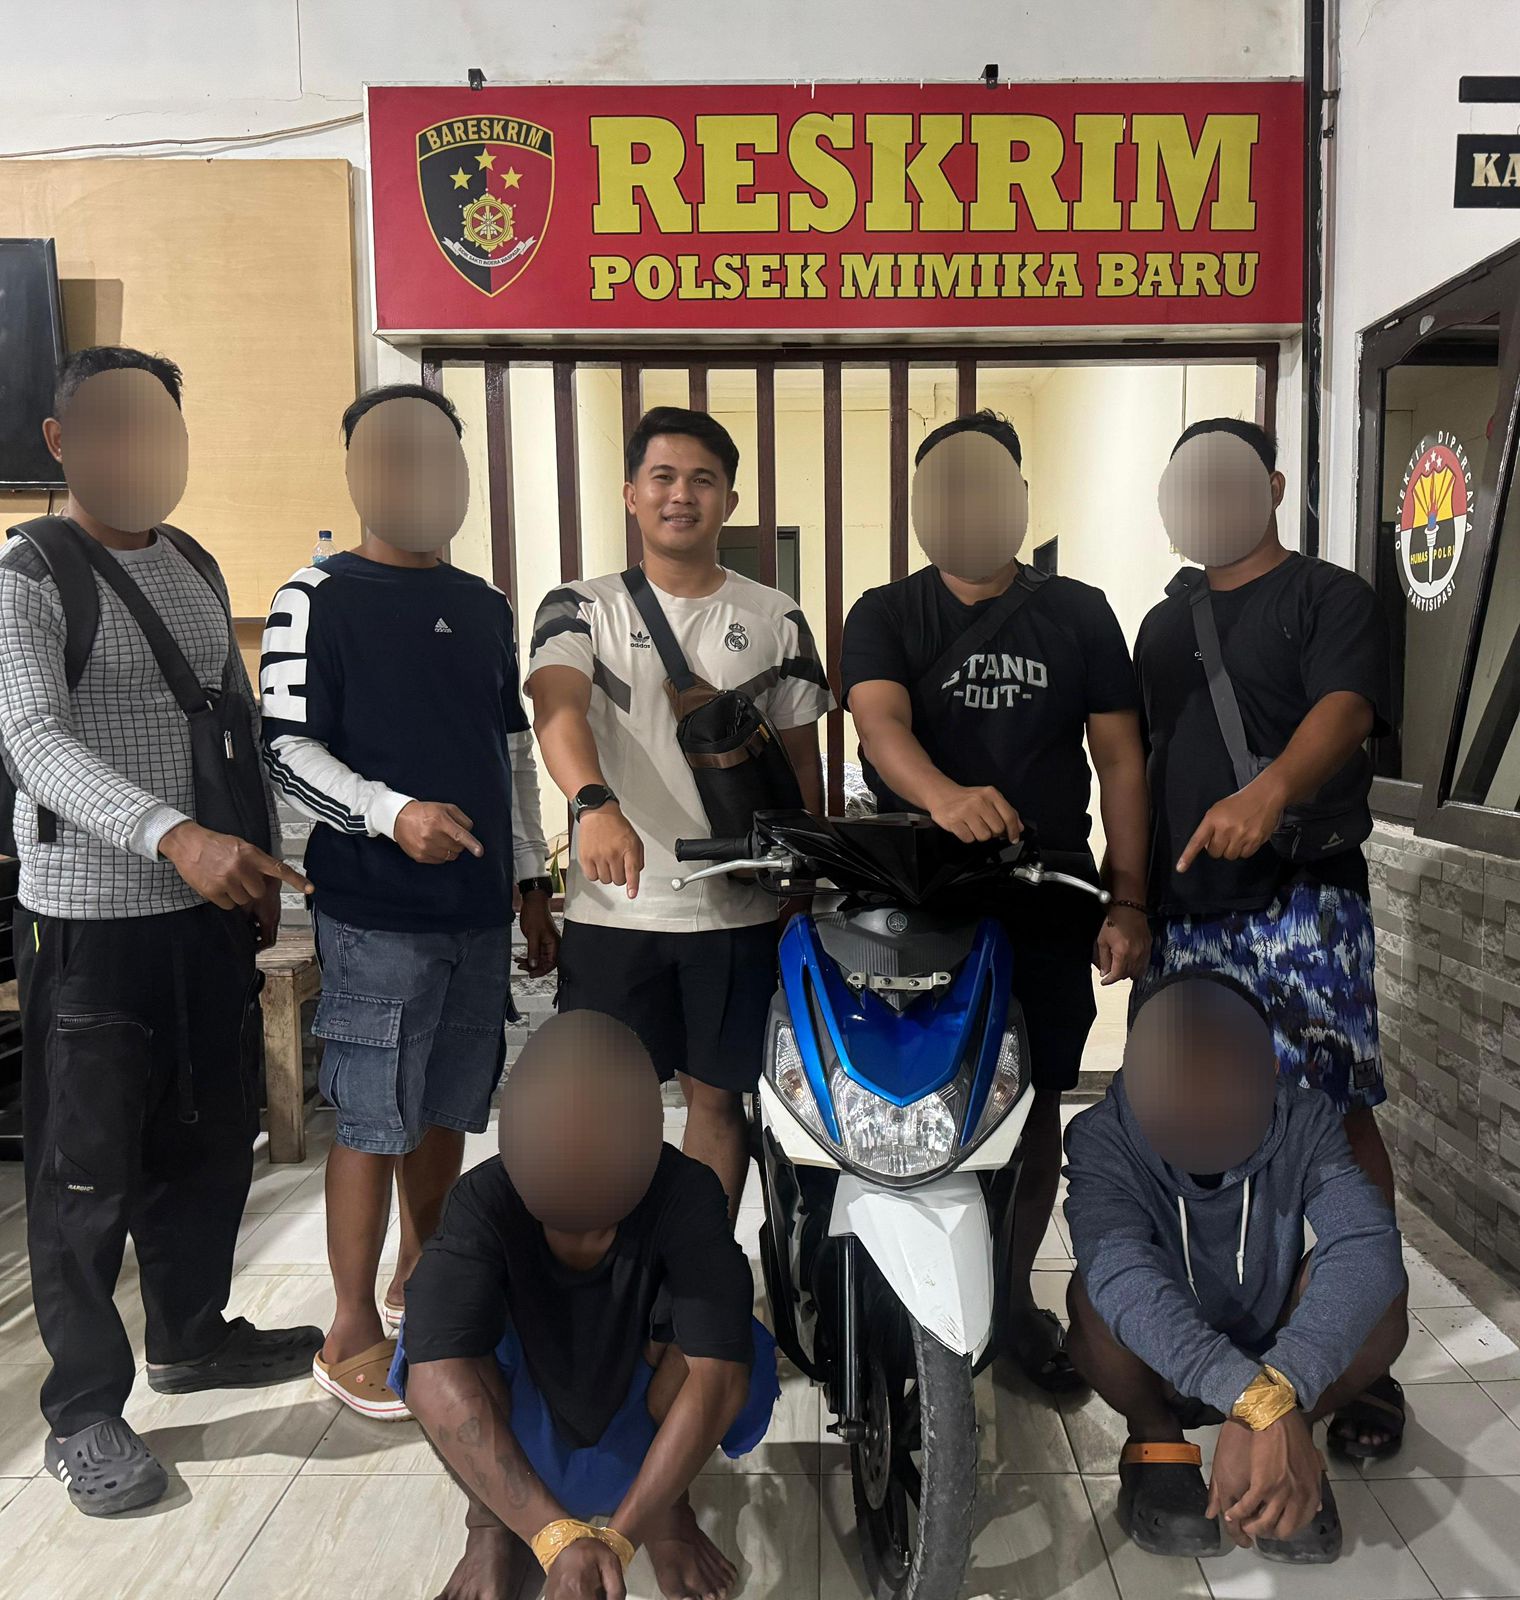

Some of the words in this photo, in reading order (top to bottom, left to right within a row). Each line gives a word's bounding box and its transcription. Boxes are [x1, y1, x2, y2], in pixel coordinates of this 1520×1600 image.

[426, 119, 544, 150] BARESKRIM
[590, 112, 1259, 234] RESKRIM
[590, 253, 827, 300] POLSEK
[840, 252, 1083, 298] MIMIKA
[1097, 252, 1259, 297] BARU
[1395, 440, 1426, 550] OBYEKTIF
[1438, 430, 1474, 532] DIPERCAYA
[1410, 550, 1428, 565] HUMAS
[1407, 579, 1456, 612] PARTISIPASI
